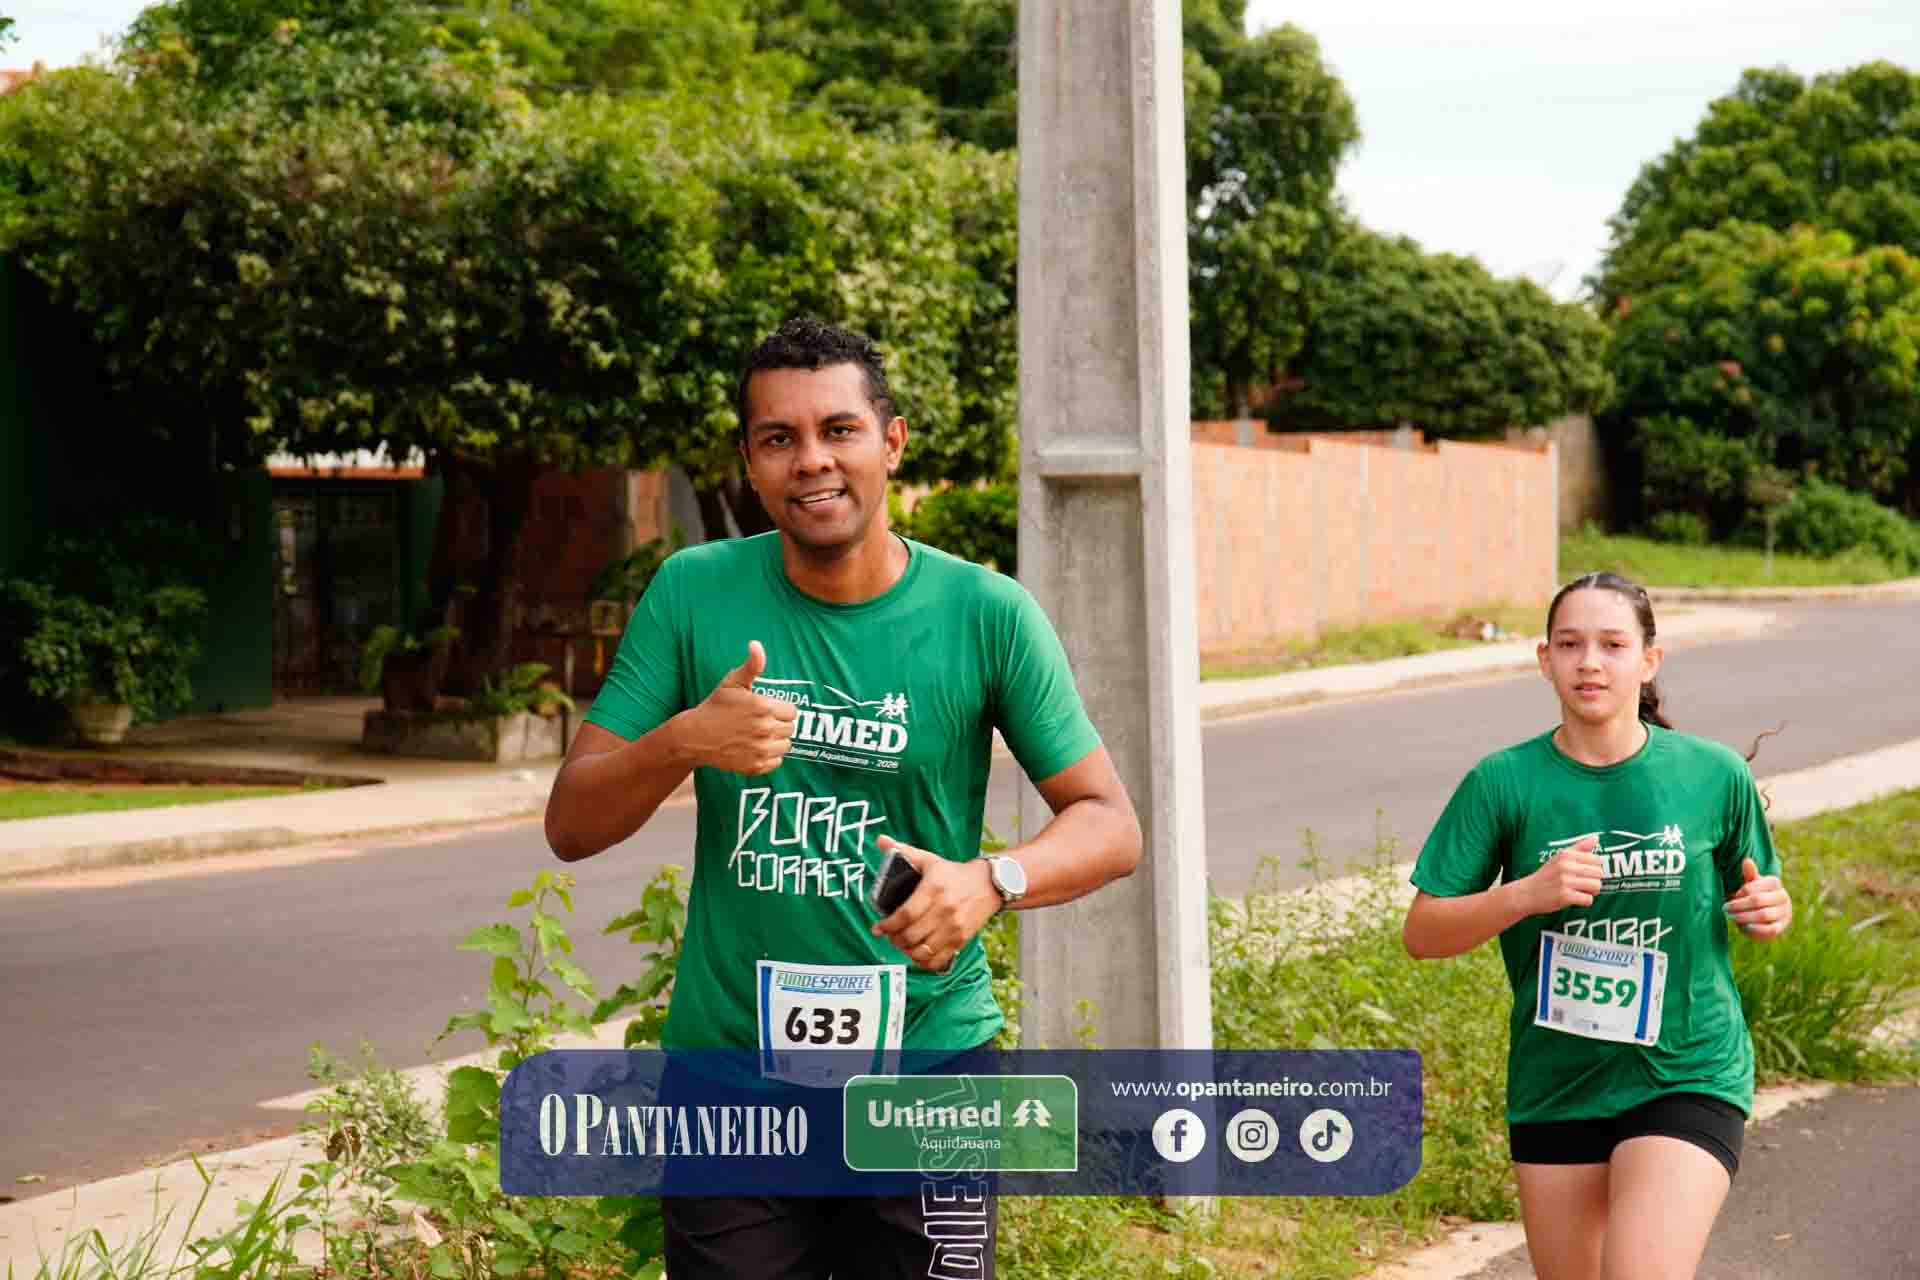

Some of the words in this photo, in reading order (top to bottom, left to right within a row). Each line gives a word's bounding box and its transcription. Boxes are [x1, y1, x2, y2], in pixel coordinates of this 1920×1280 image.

[752, 686, 810, 707] ORRIDA
[791, 709, 908, 753] IMED
[728, 787, 886, 869] BORA
[737, 850, 865, 900] CORRER
[1600, 849, 1687, 879] IMED
[776, 970, 873, 990] FUNDESPORTE
[1552, 966, 1638, 1008] 3559
[785, 1006, 861, 1045] 633
